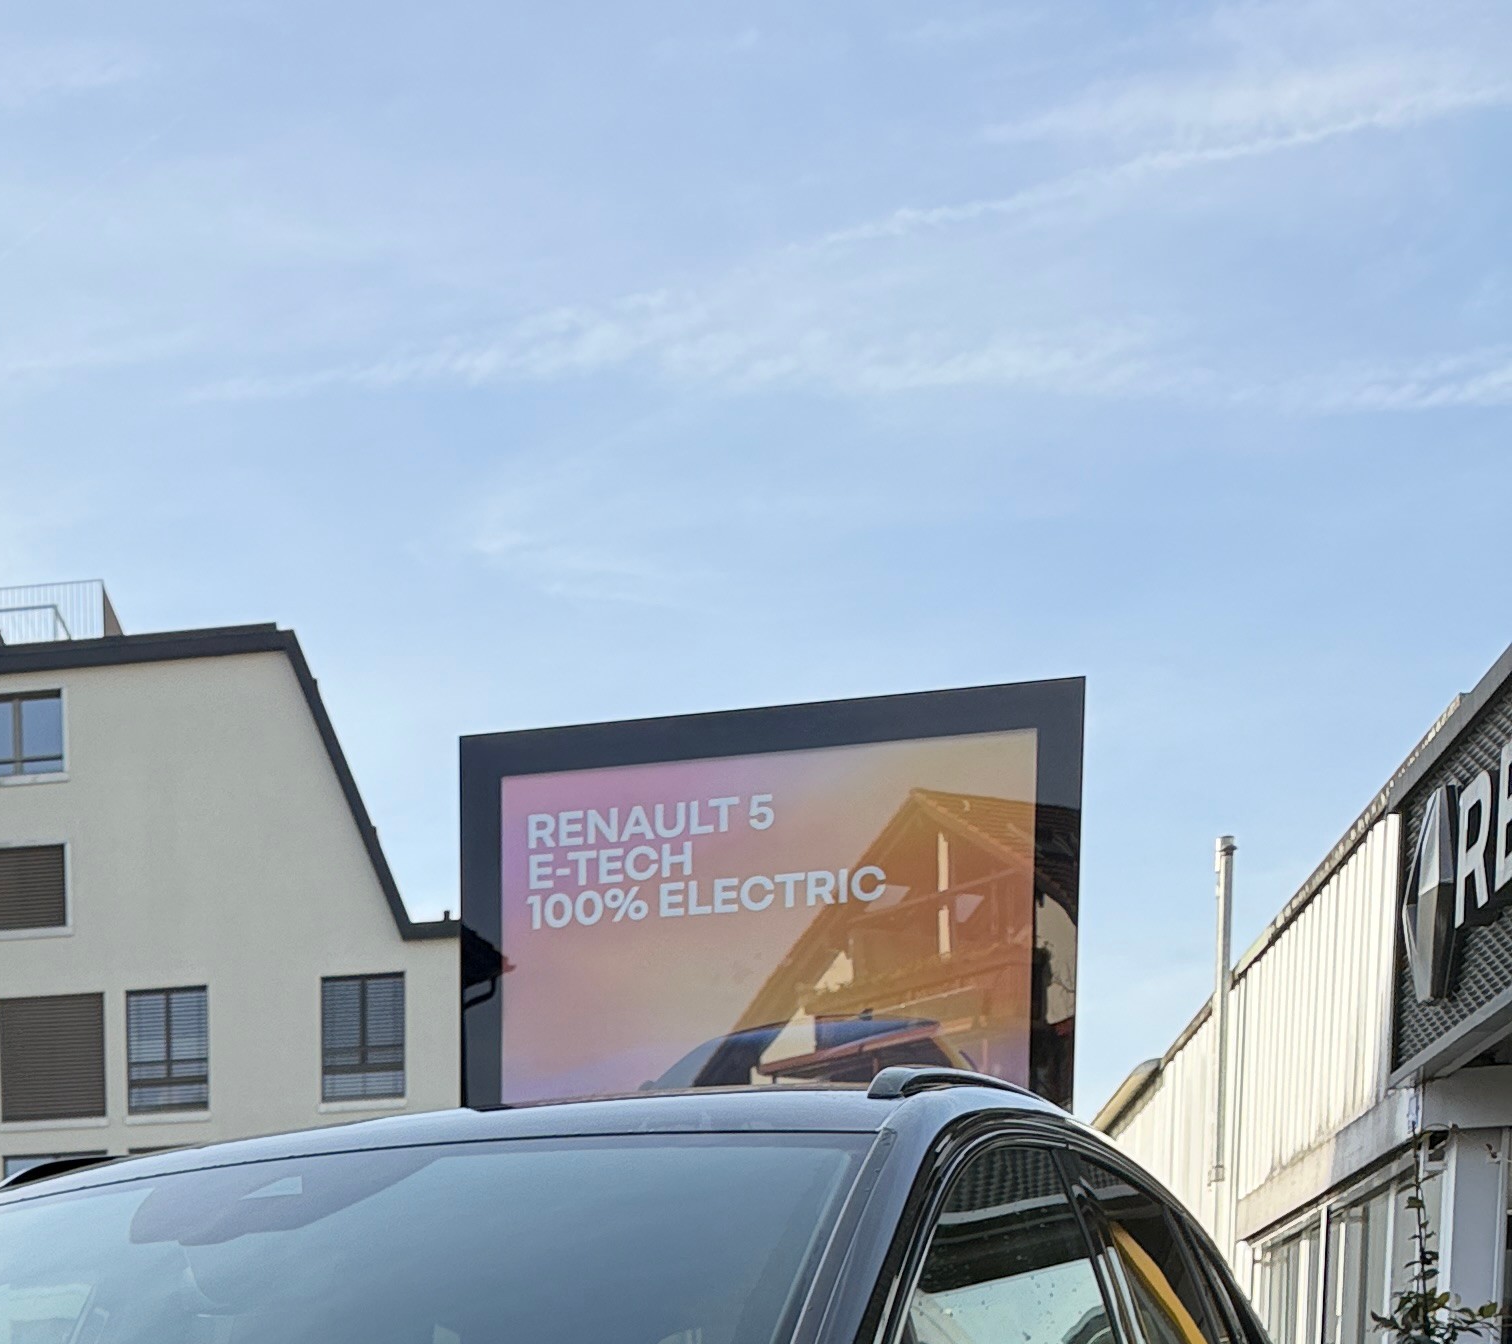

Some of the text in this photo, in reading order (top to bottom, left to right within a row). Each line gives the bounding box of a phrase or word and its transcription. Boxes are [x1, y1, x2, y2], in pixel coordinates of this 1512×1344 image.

[527, 793, 775, 849] RENAULT 5
[528, 840, 693, 890] E-TECH
[526, 865, 887, 930] 100% ELECTRIC
